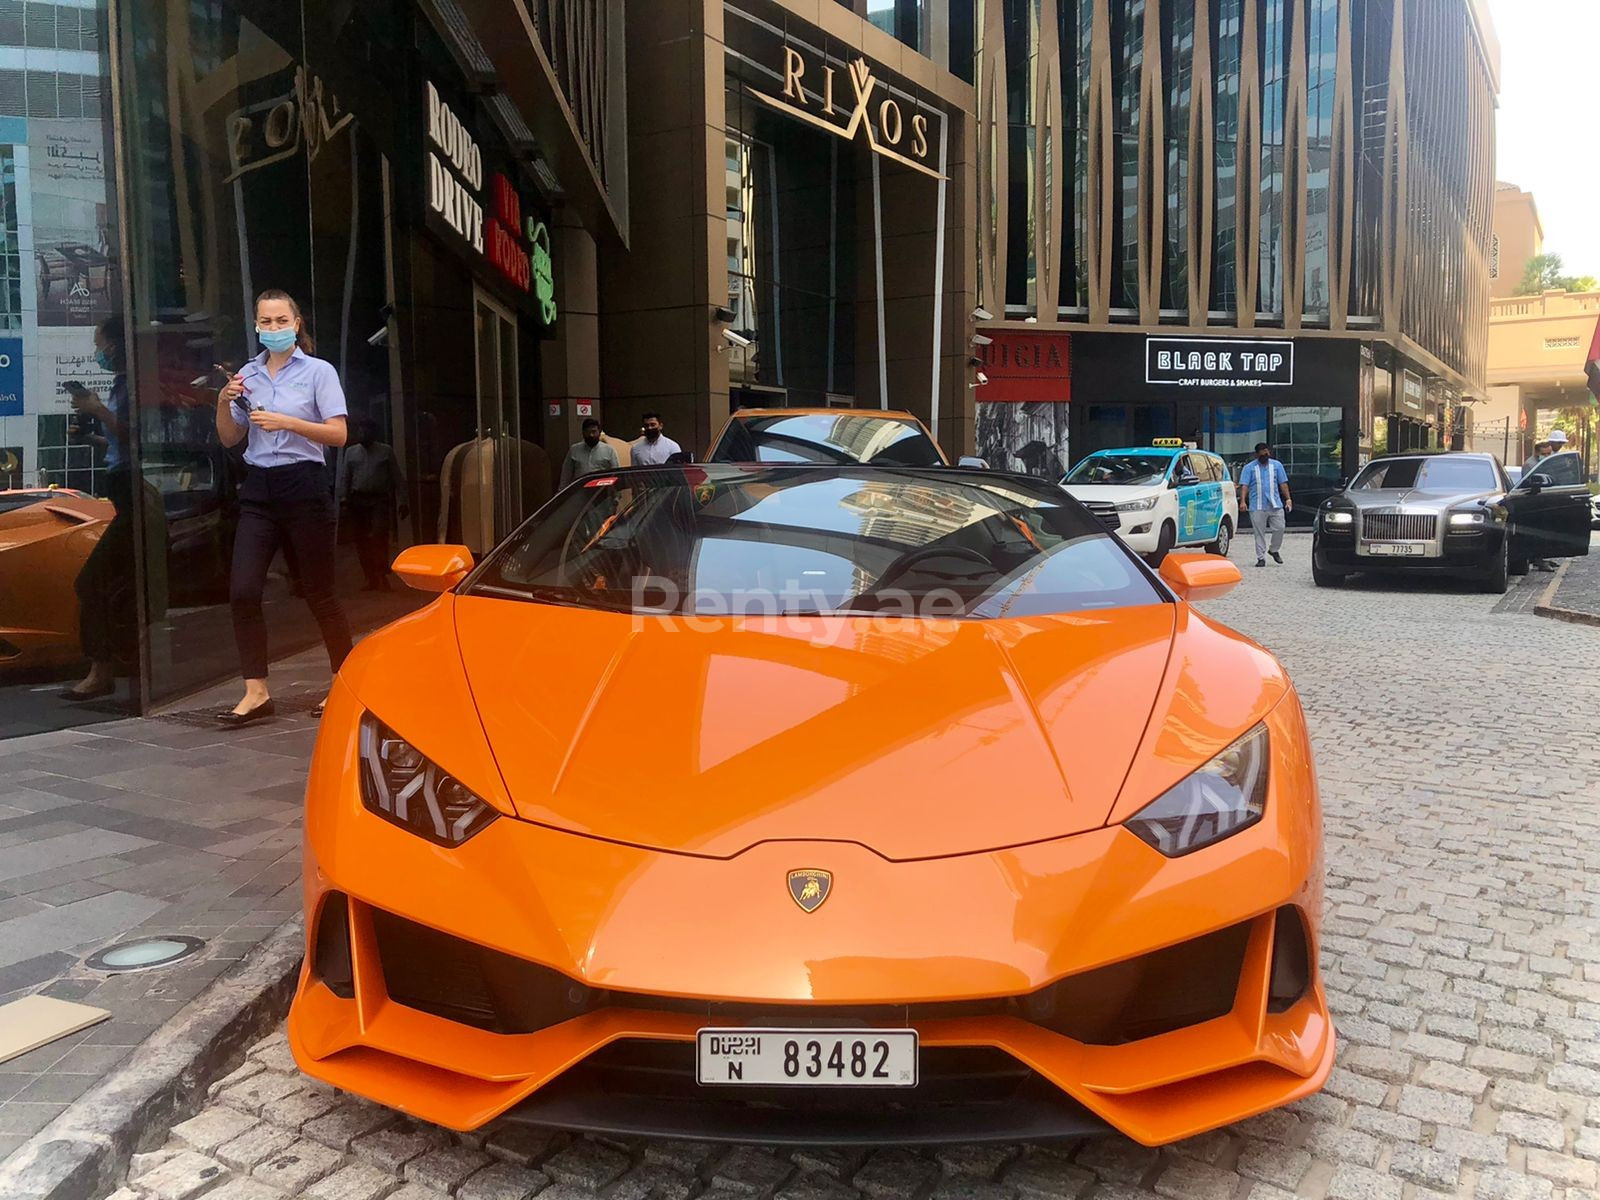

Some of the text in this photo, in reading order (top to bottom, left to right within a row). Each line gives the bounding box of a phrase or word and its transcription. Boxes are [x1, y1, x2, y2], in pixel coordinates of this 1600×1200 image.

[783, 46, 928, 158] RIXOS
[427, 80, 482, 192] RODEO
[429, 152, 484, 254] DRIVE
[1157, 351, 1283, 371] BLACK TAP
[1178, 378, 1199, 386] CRAFT
[1200, 378, 1229, 386] BURGERS
[1236, 379, 1262, 387] SHAKES
[728, 1061, 742, 1080] N
[783, 1040, 890, 1078] 83482
